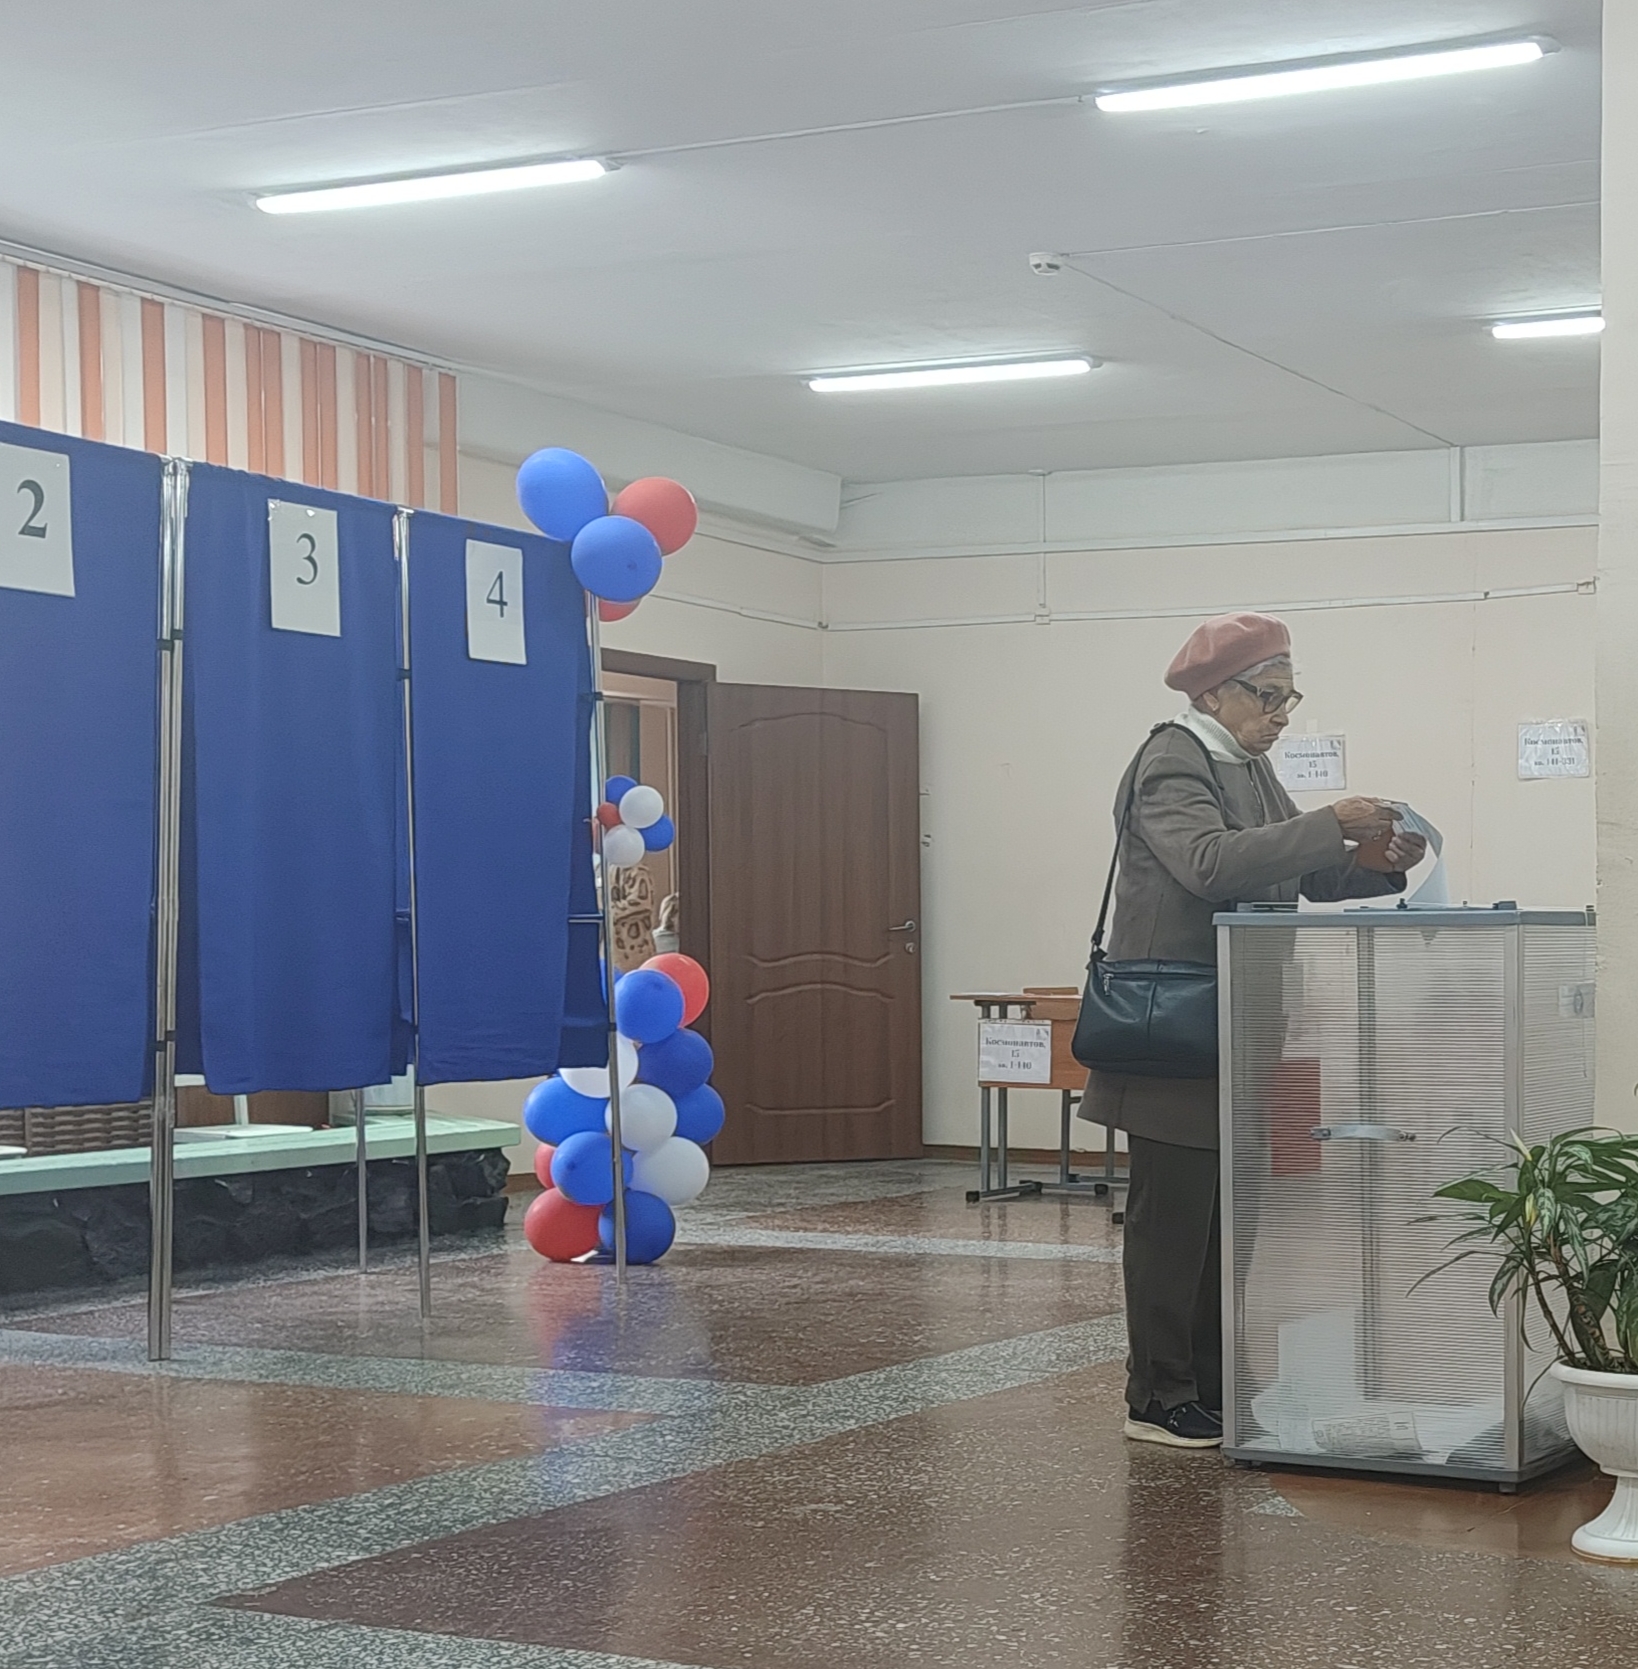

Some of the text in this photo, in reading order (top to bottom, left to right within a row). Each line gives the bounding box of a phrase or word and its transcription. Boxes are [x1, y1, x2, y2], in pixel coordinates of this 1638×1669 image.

[16, 479, 49, 540] 2
[295, 533, 318, 586] 3
[485, 571, 509, 619] 4
